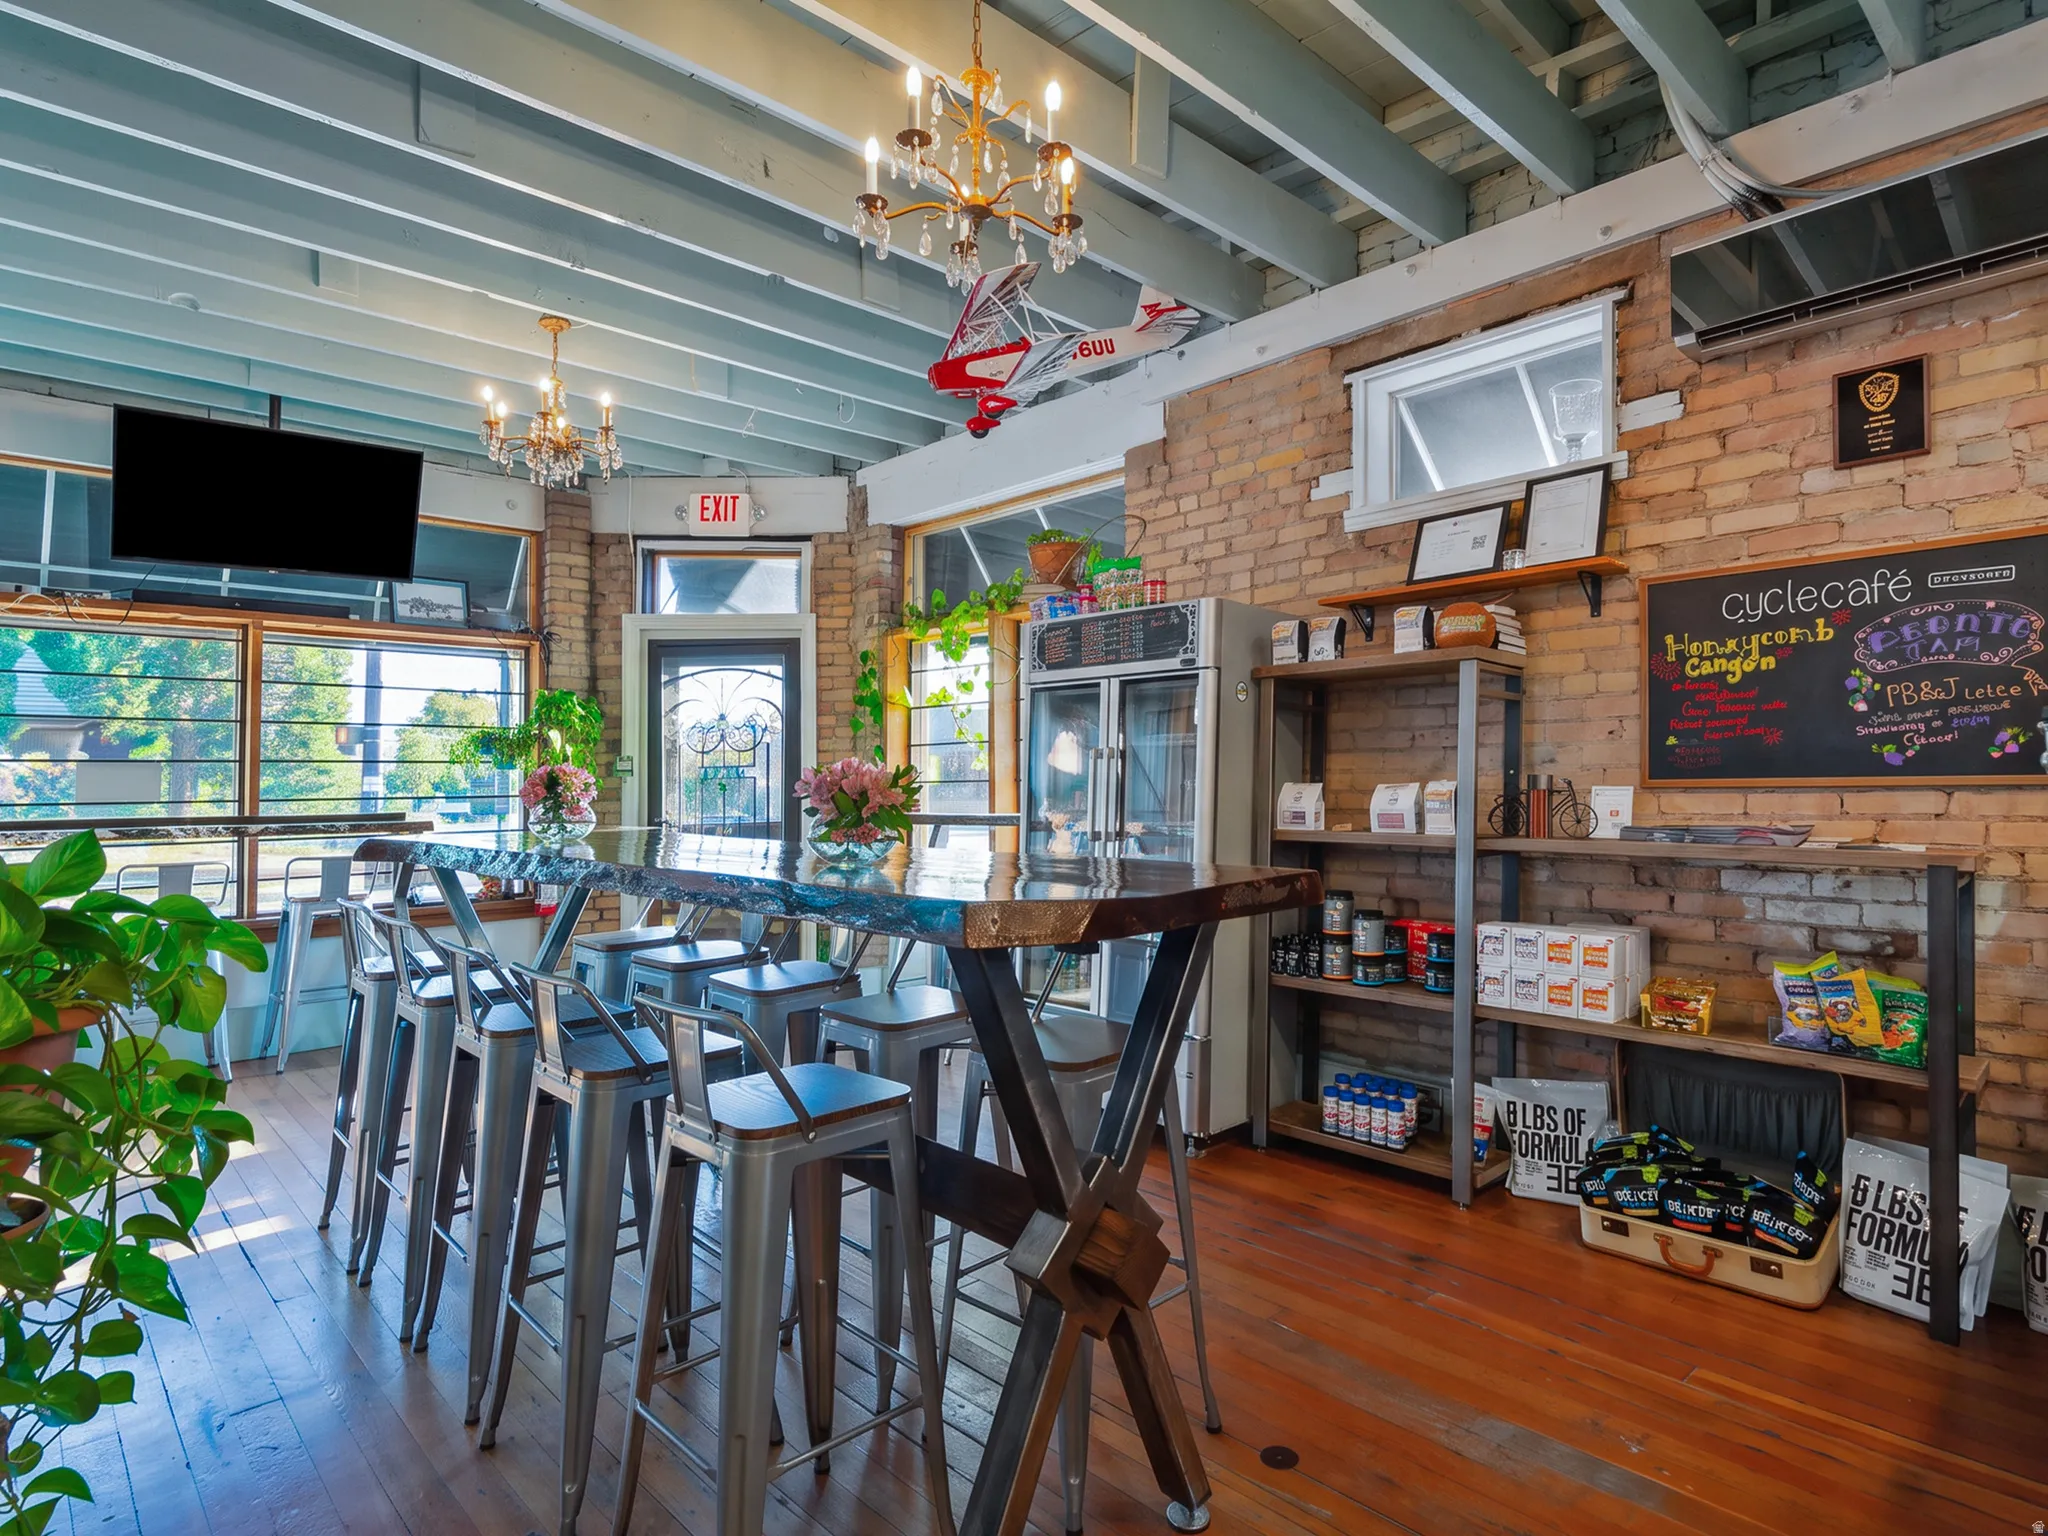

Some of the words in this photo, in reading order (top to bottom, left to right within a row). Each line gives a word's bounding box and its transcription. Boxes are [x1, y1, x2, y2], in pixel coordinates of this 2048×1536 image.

[700, 495, 740, 522] EXIT
[1722, 568, 1912, 624] cyclecafé
[1522, 1102, 1559, 1133] LBS
[1563, 1107, 1587, 1136] OF
[1509, 1128, 1595, 1165] FORMUL
[1871, 1179, 1927, 1226] LBS
